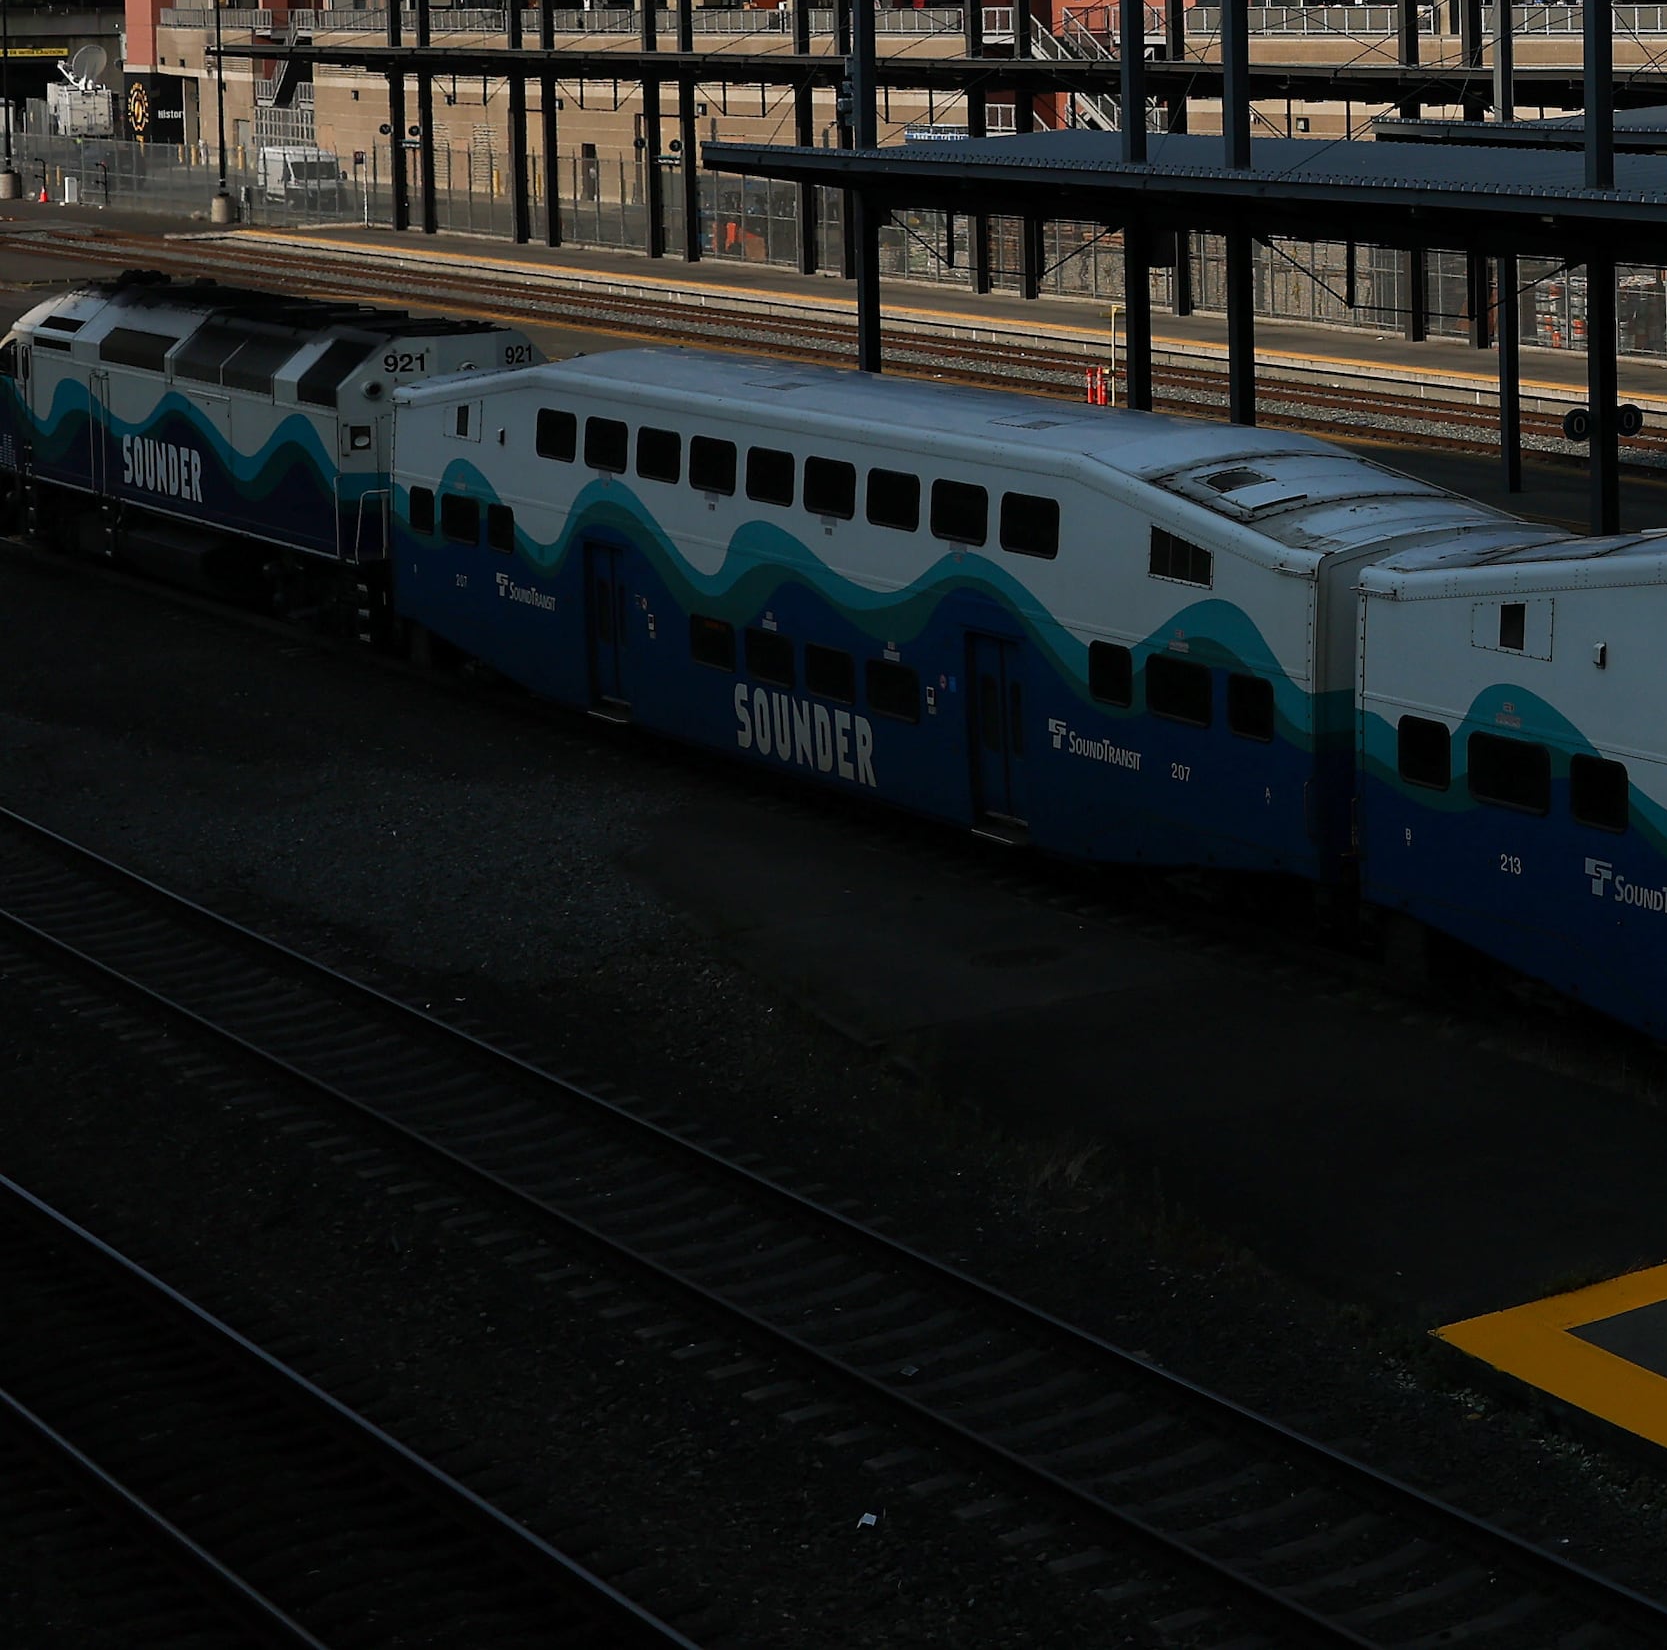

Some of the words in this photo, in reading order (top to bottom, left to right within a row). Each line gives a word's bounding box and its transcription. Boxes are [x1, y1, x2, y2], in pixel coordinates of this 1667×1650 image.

[384, 353, 425, 373] 921
[505, 344, 532, 365] 921
[122, 433, 203, 503] SOUNDER
[734, 682, 877, 788] SOUNDER
[1170, 762, 1191, 782] 207
[1500, 854, 1522, 875] 213
